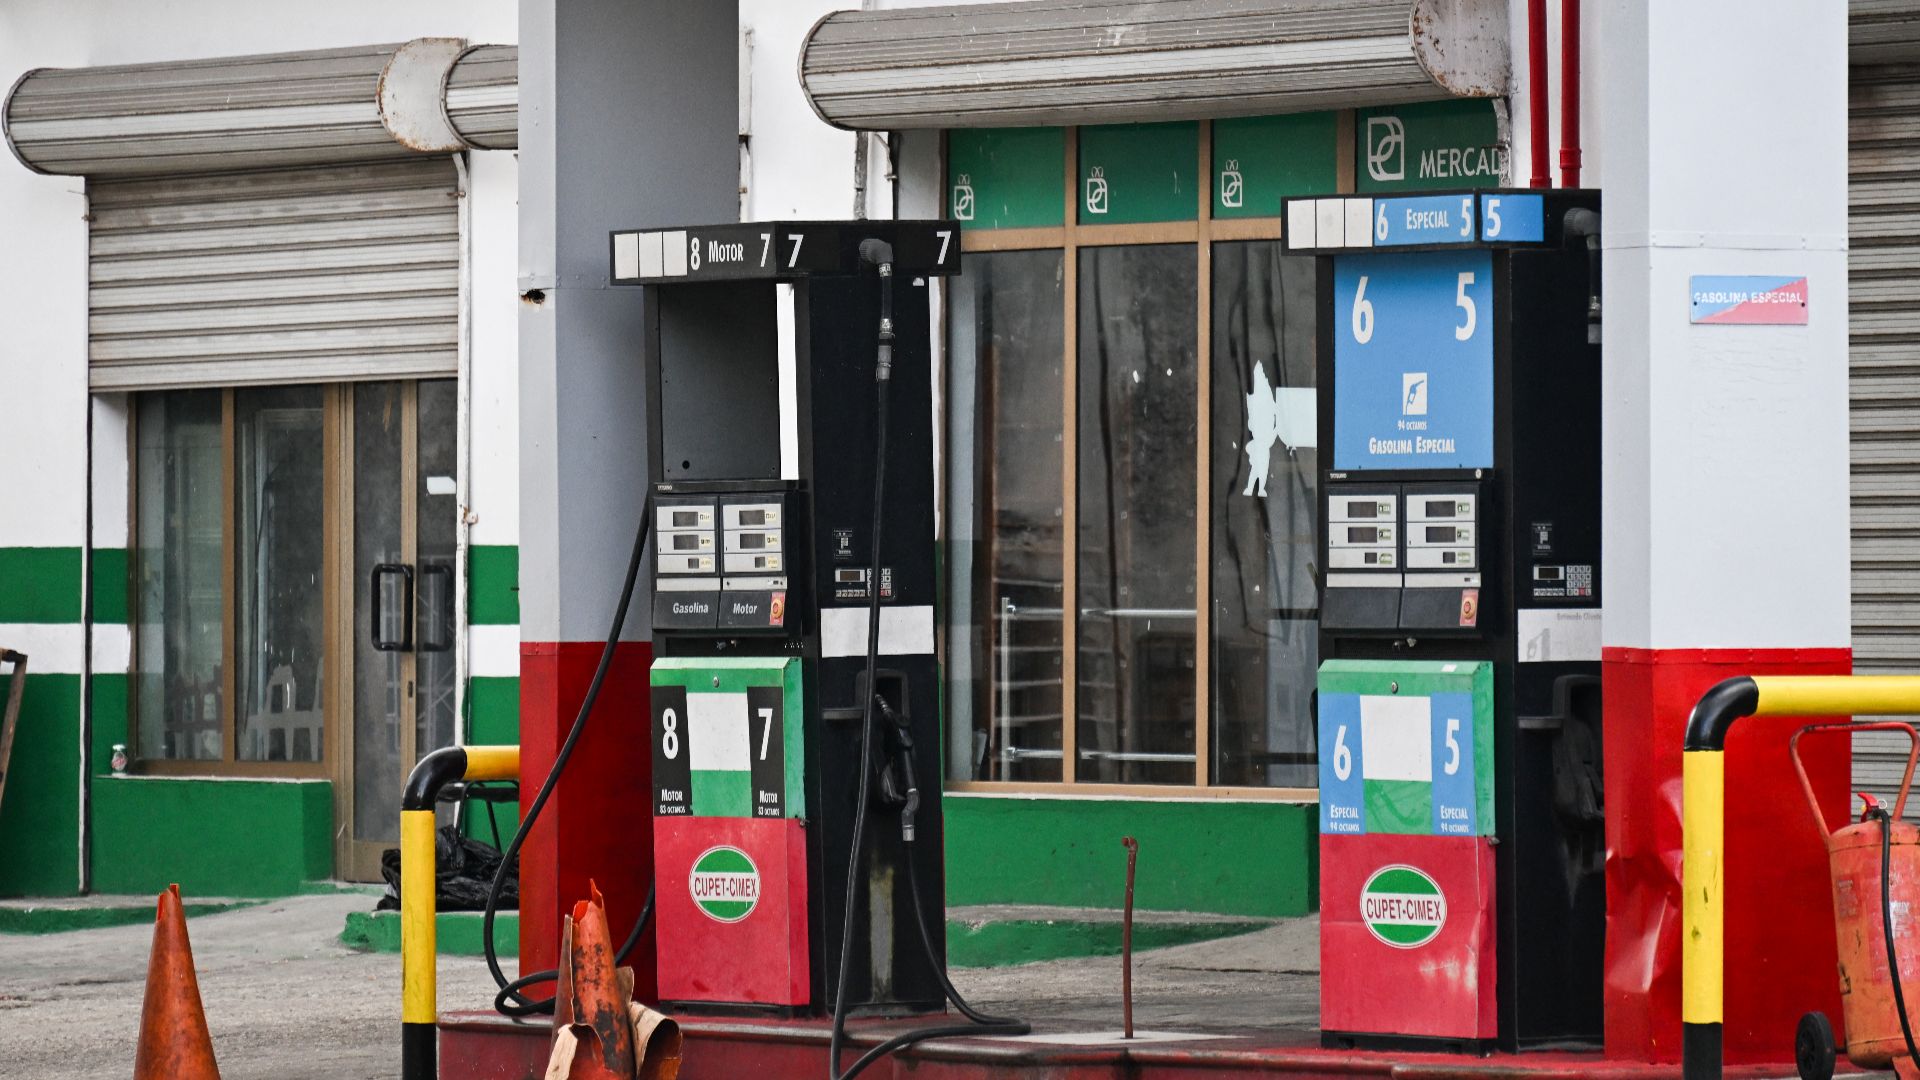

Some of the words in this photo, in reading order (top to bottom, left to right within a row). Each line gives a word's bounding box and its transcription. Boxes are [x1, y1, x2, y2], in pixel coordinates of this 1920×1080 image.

[1376, 203, 1389, 241] 6
[1406, 208, 1449, 230] ESPECIAL
[1460, 199, 1472, 238] 5
[1486, 199, 1501, 238] 5
[690, 237, 700, 271] 8
[708, 241, 744, 263] MOTOR
[760, 233, 771, 268] 7
[788, 234, 804, 268] 7
[936, 231, 952, 265] 7
[1352, 276, 1374, 344] 6
[1455, 272, 1476, 341] 5
[1693, 292, 1748, 303] GASOLINA
[1751, 292, 1803, 304] ESPECIAL
[1369, 437, 1412, 454] GASOLINA
[1416, 436, 1455, 453] ESPECIAL
[673, 602, 709, 614] Gasolina
[733, 603, 757, 614] Motor
[662, 708, 679, 759] 8
[757, 708, 773, 760] 7
[1444, 718, 1460, 776] 5
[1333, 725, 1351, 781] 6
[661, 789, 683, 802] MOTOR
[759, 790, 778, 804] MOTOR
[1330, 804, 1359, 819] ESPECIAL
[1440, 805, 1469, 820] ESPECIAL
[694, 877, 757, 897] CUPET-CIMEX
[1366, 898, 1442, 921] CUPET-CIMEX
